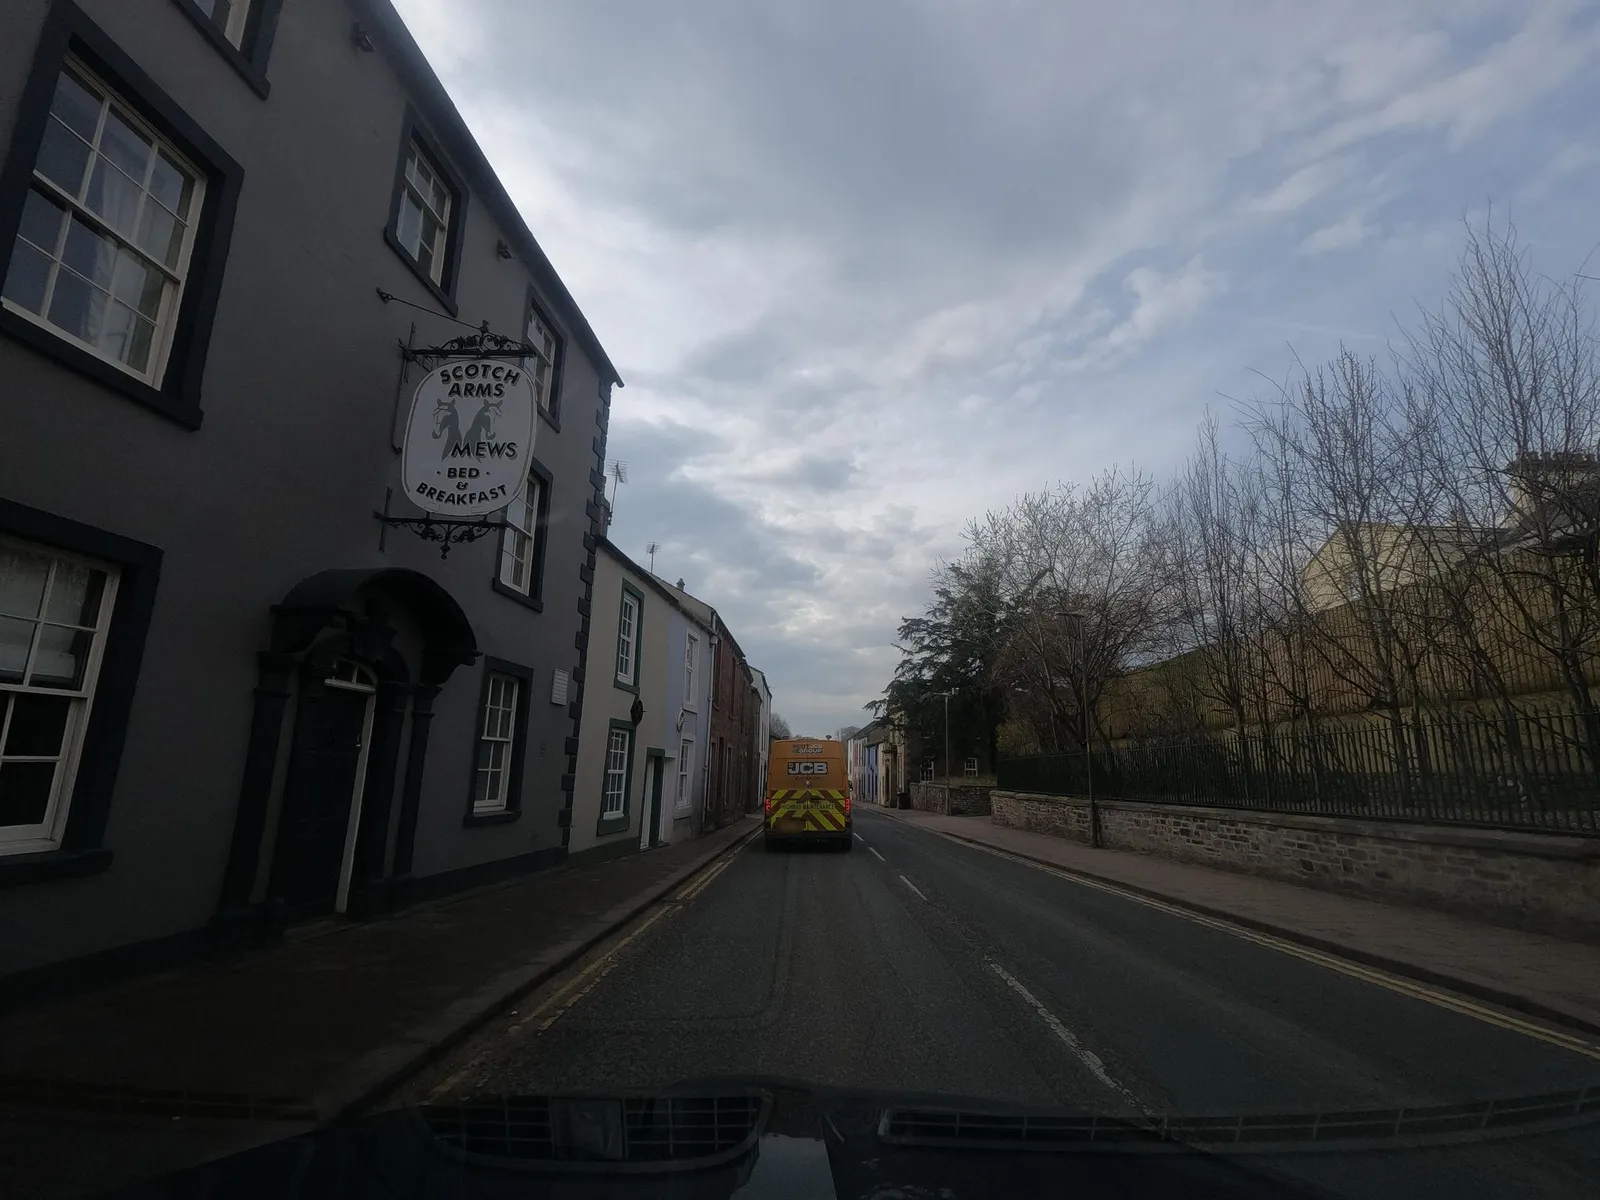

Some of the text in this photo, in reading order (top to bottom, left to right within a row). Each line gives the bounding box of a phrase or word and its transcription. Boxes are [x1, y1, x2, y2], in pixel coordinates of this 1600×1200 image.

[440, 364, 521, 385] SCOTCH
[448, 383, 506, 398] ARMS
[451, 441, 518, 459] MEWS
[447, 467, 480, 479] BED
[456, 481, 469, 491] &
[416, 482, 508, 506] BREAKFAST
[788, 762, 828, 774] JCB
